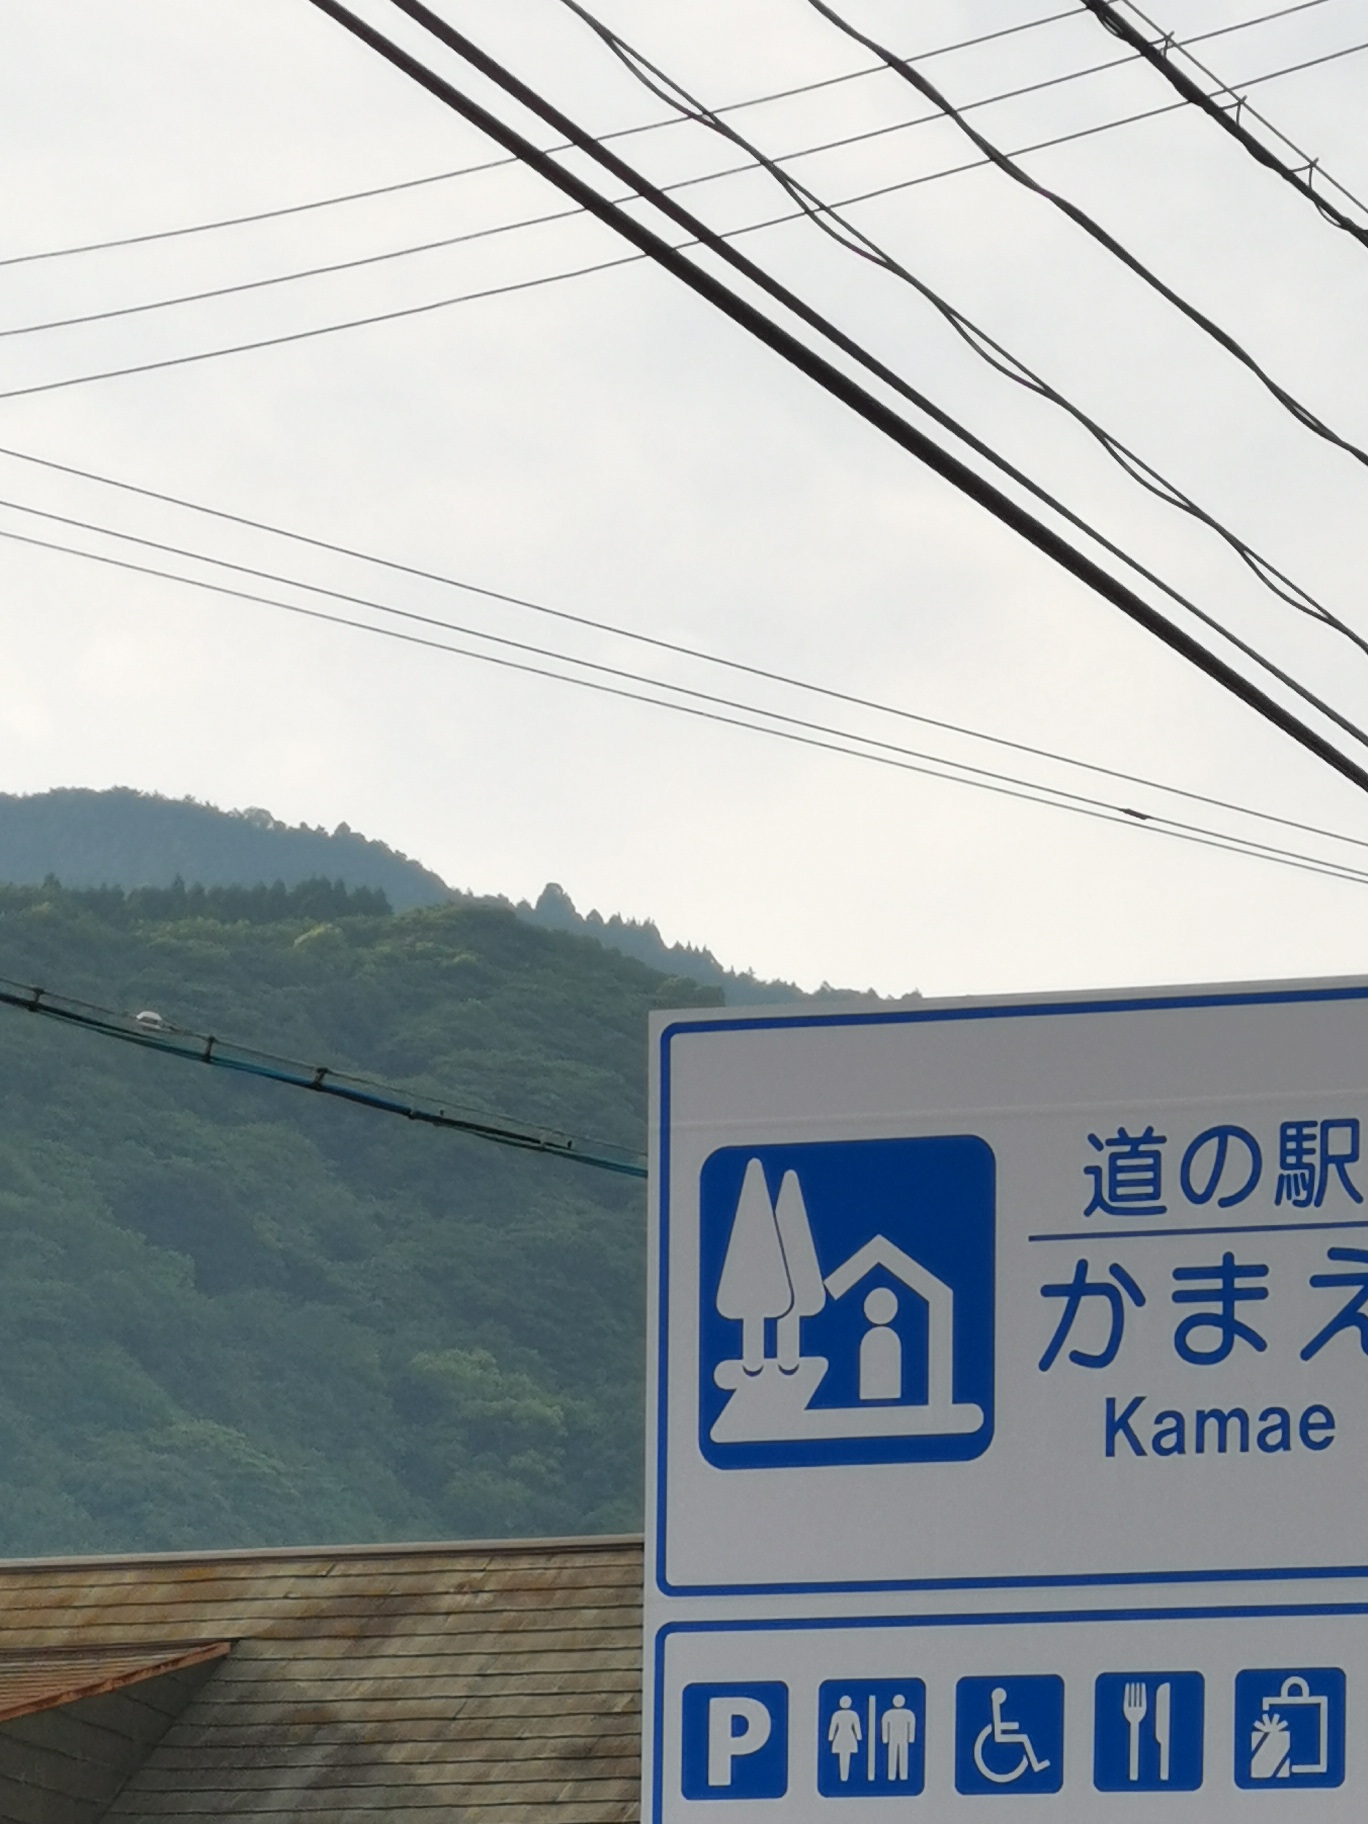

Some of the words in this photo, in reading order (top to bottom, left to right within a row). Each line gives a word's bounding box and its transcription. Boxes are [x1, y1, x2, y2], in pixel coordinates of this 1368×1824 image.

[1083, 1117, 1362, 1218] 道の駅
[1105, 1396, 1336, 1458] Kamae
[708, 1696, 772, 1787] P
